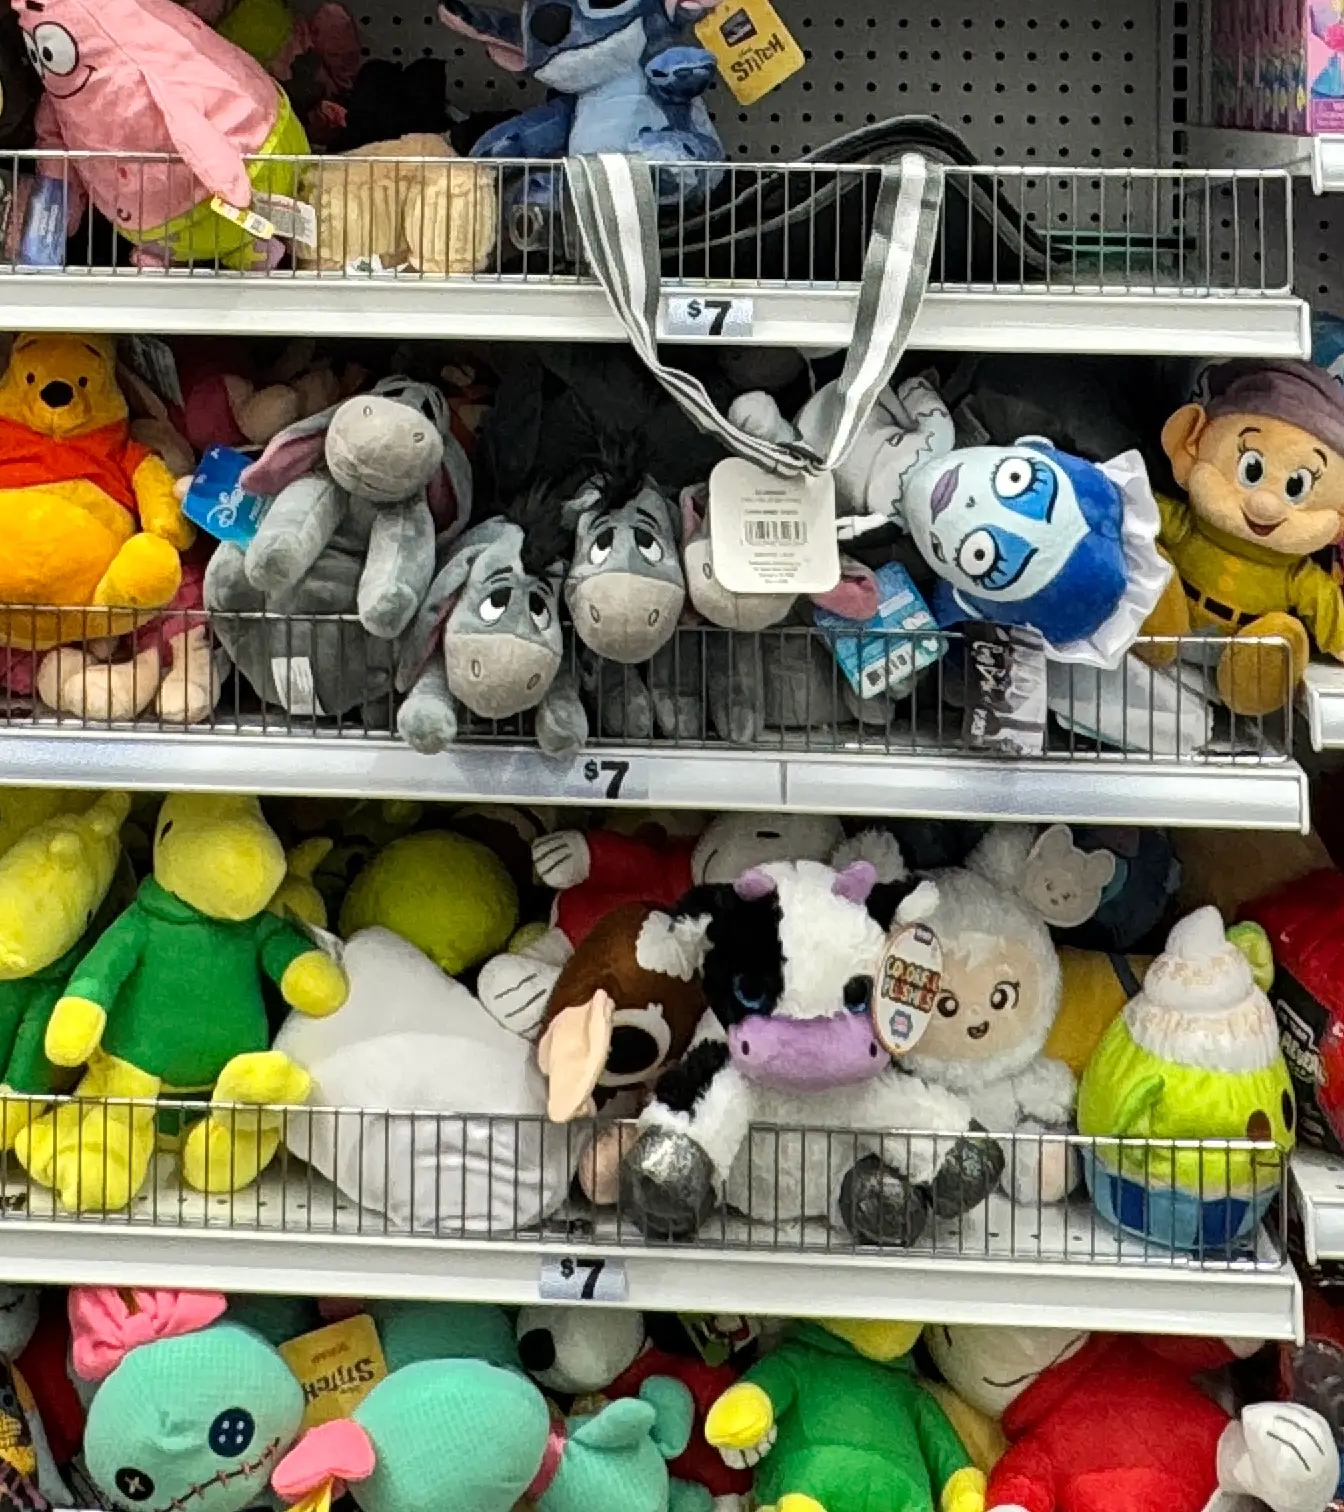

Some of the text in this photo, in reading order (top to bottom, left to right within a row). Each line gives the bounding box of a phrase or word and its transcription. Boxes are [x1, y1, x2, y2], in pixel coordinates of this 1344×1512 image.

[687, 300, 732, 336] $7
[584, 759, 630, 800] $7
[560, 1256, 606, 1300] $7
